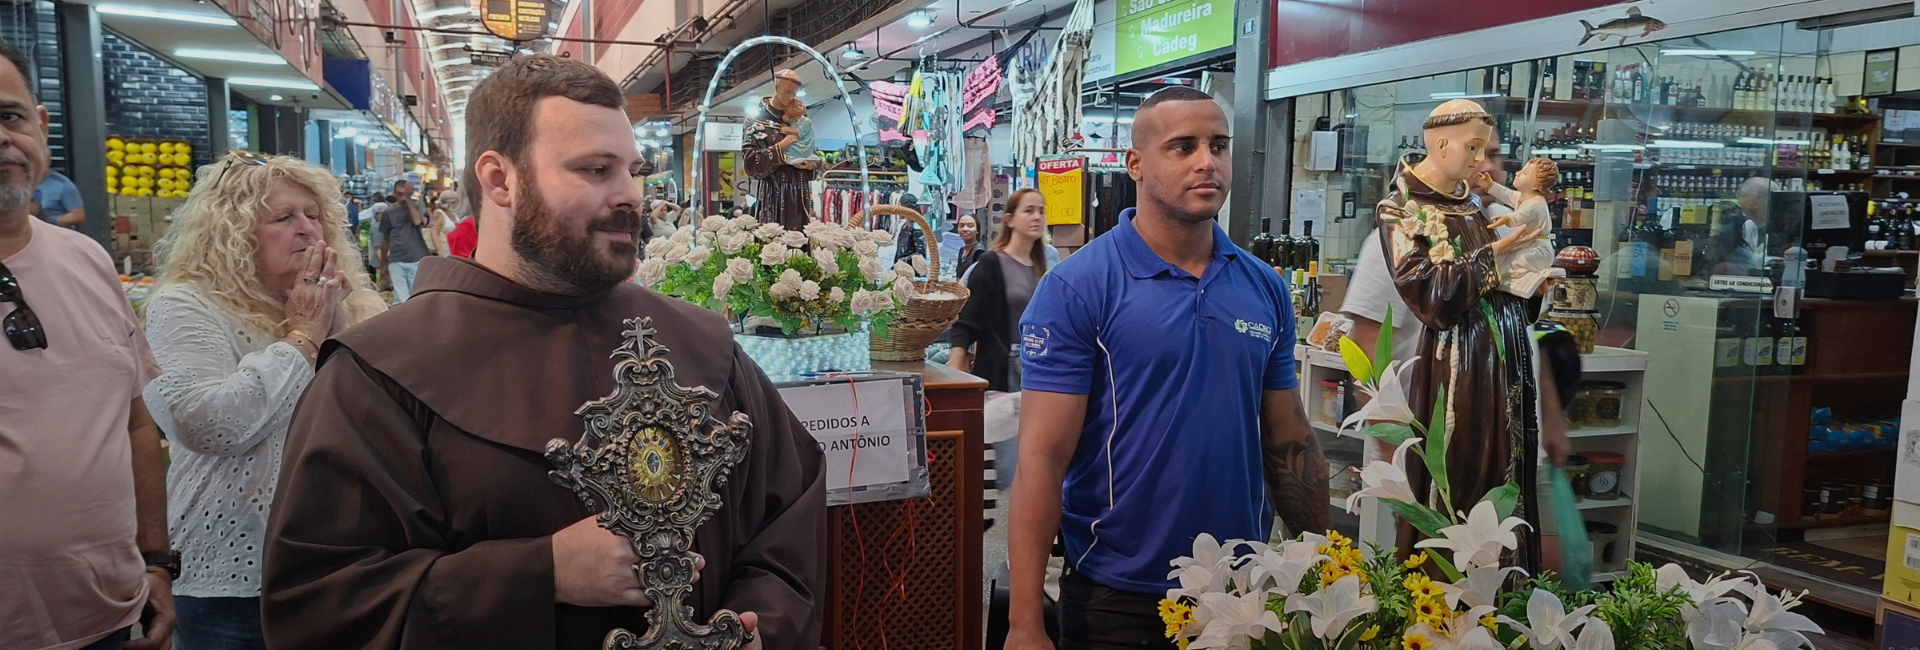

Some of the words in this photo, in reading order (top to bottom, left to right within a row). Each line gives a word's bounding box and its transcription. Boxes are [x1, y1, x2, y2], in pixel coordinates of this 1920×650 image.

[1141, 2, 1212, 36] Madureira
[1152, 33, 1197, 56] Cadeg
[1039, 159, 1079, 170] OFERTA
[801, 416, 857, 431] PEDIDOS
[861, 415, 870, 426] A
[830, 435, 890, 451] ANTÔNIO
